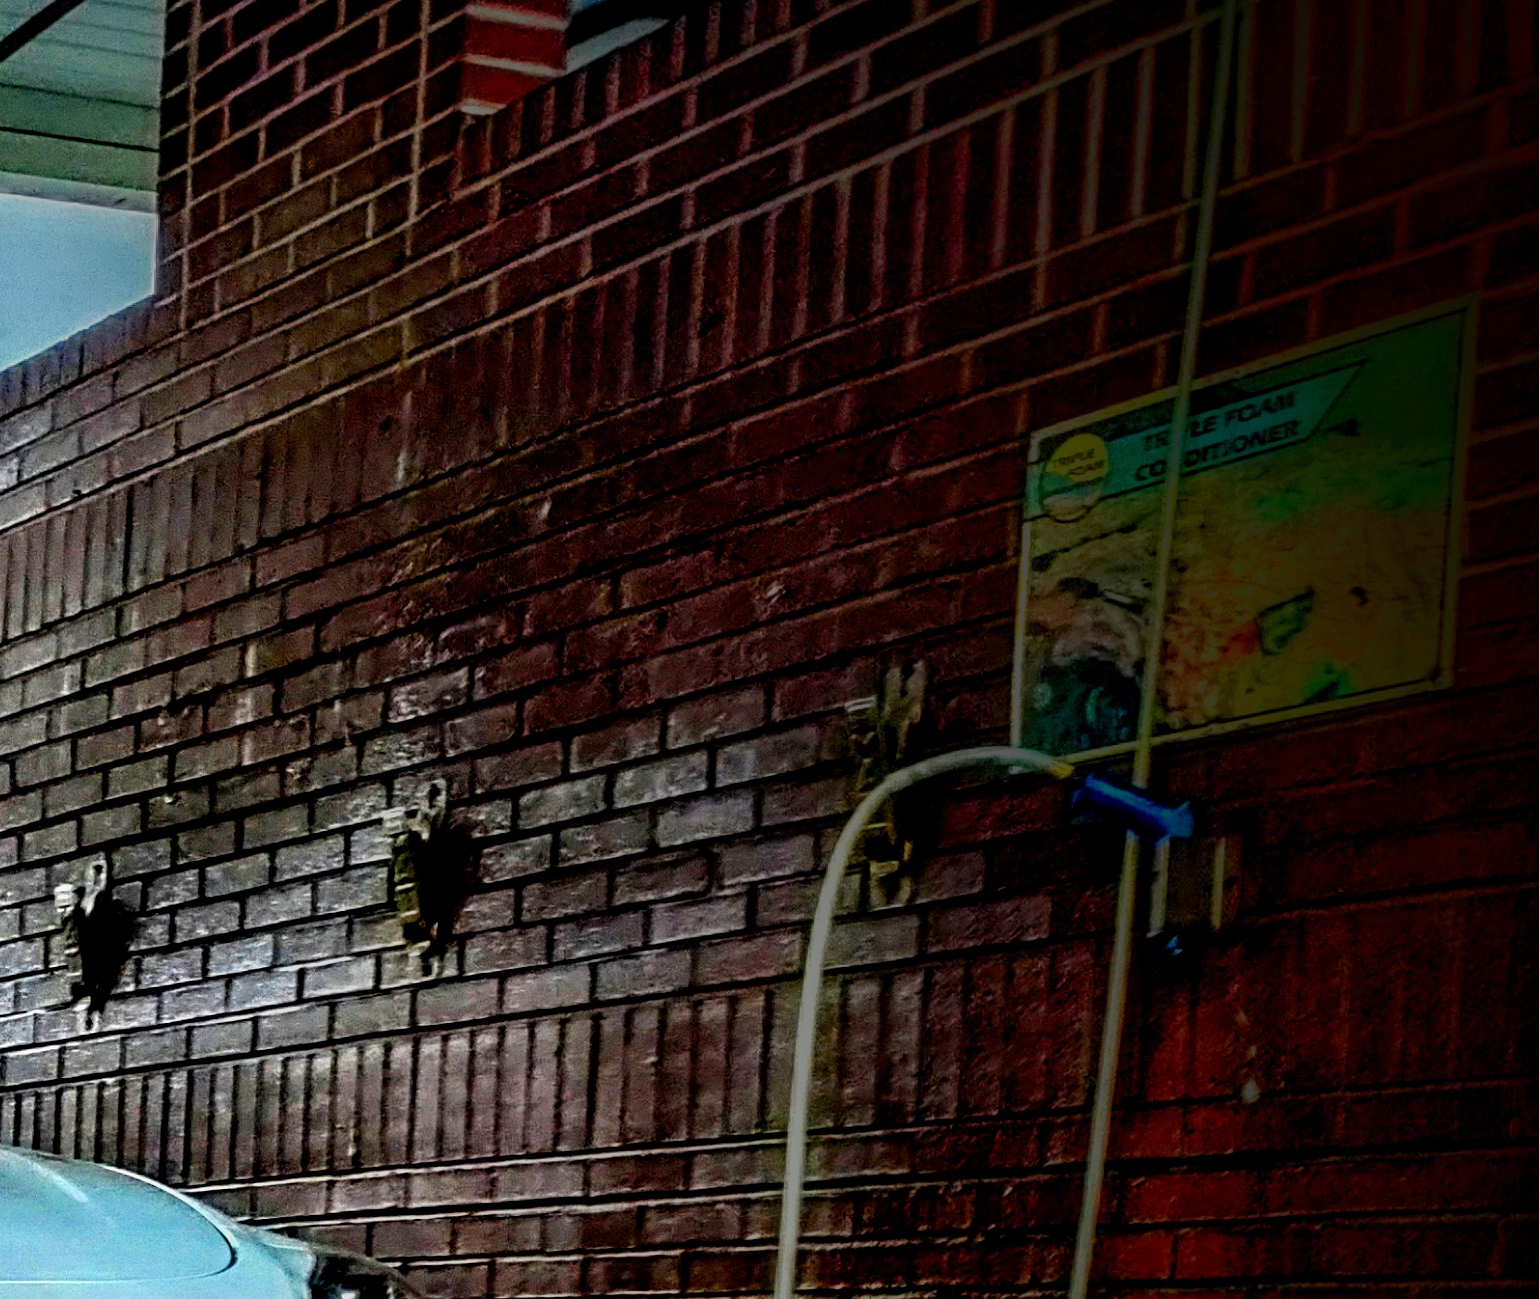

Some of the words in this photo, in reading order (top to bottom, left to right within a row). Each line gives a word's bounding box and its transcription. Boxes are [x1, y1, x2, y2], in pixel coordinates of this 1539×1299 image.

[1133, 419, 1300, 482] CODITIONER
[1143, 415, 1219, 452] TRLE
[1224, 391, 1298, 428] FOAM
